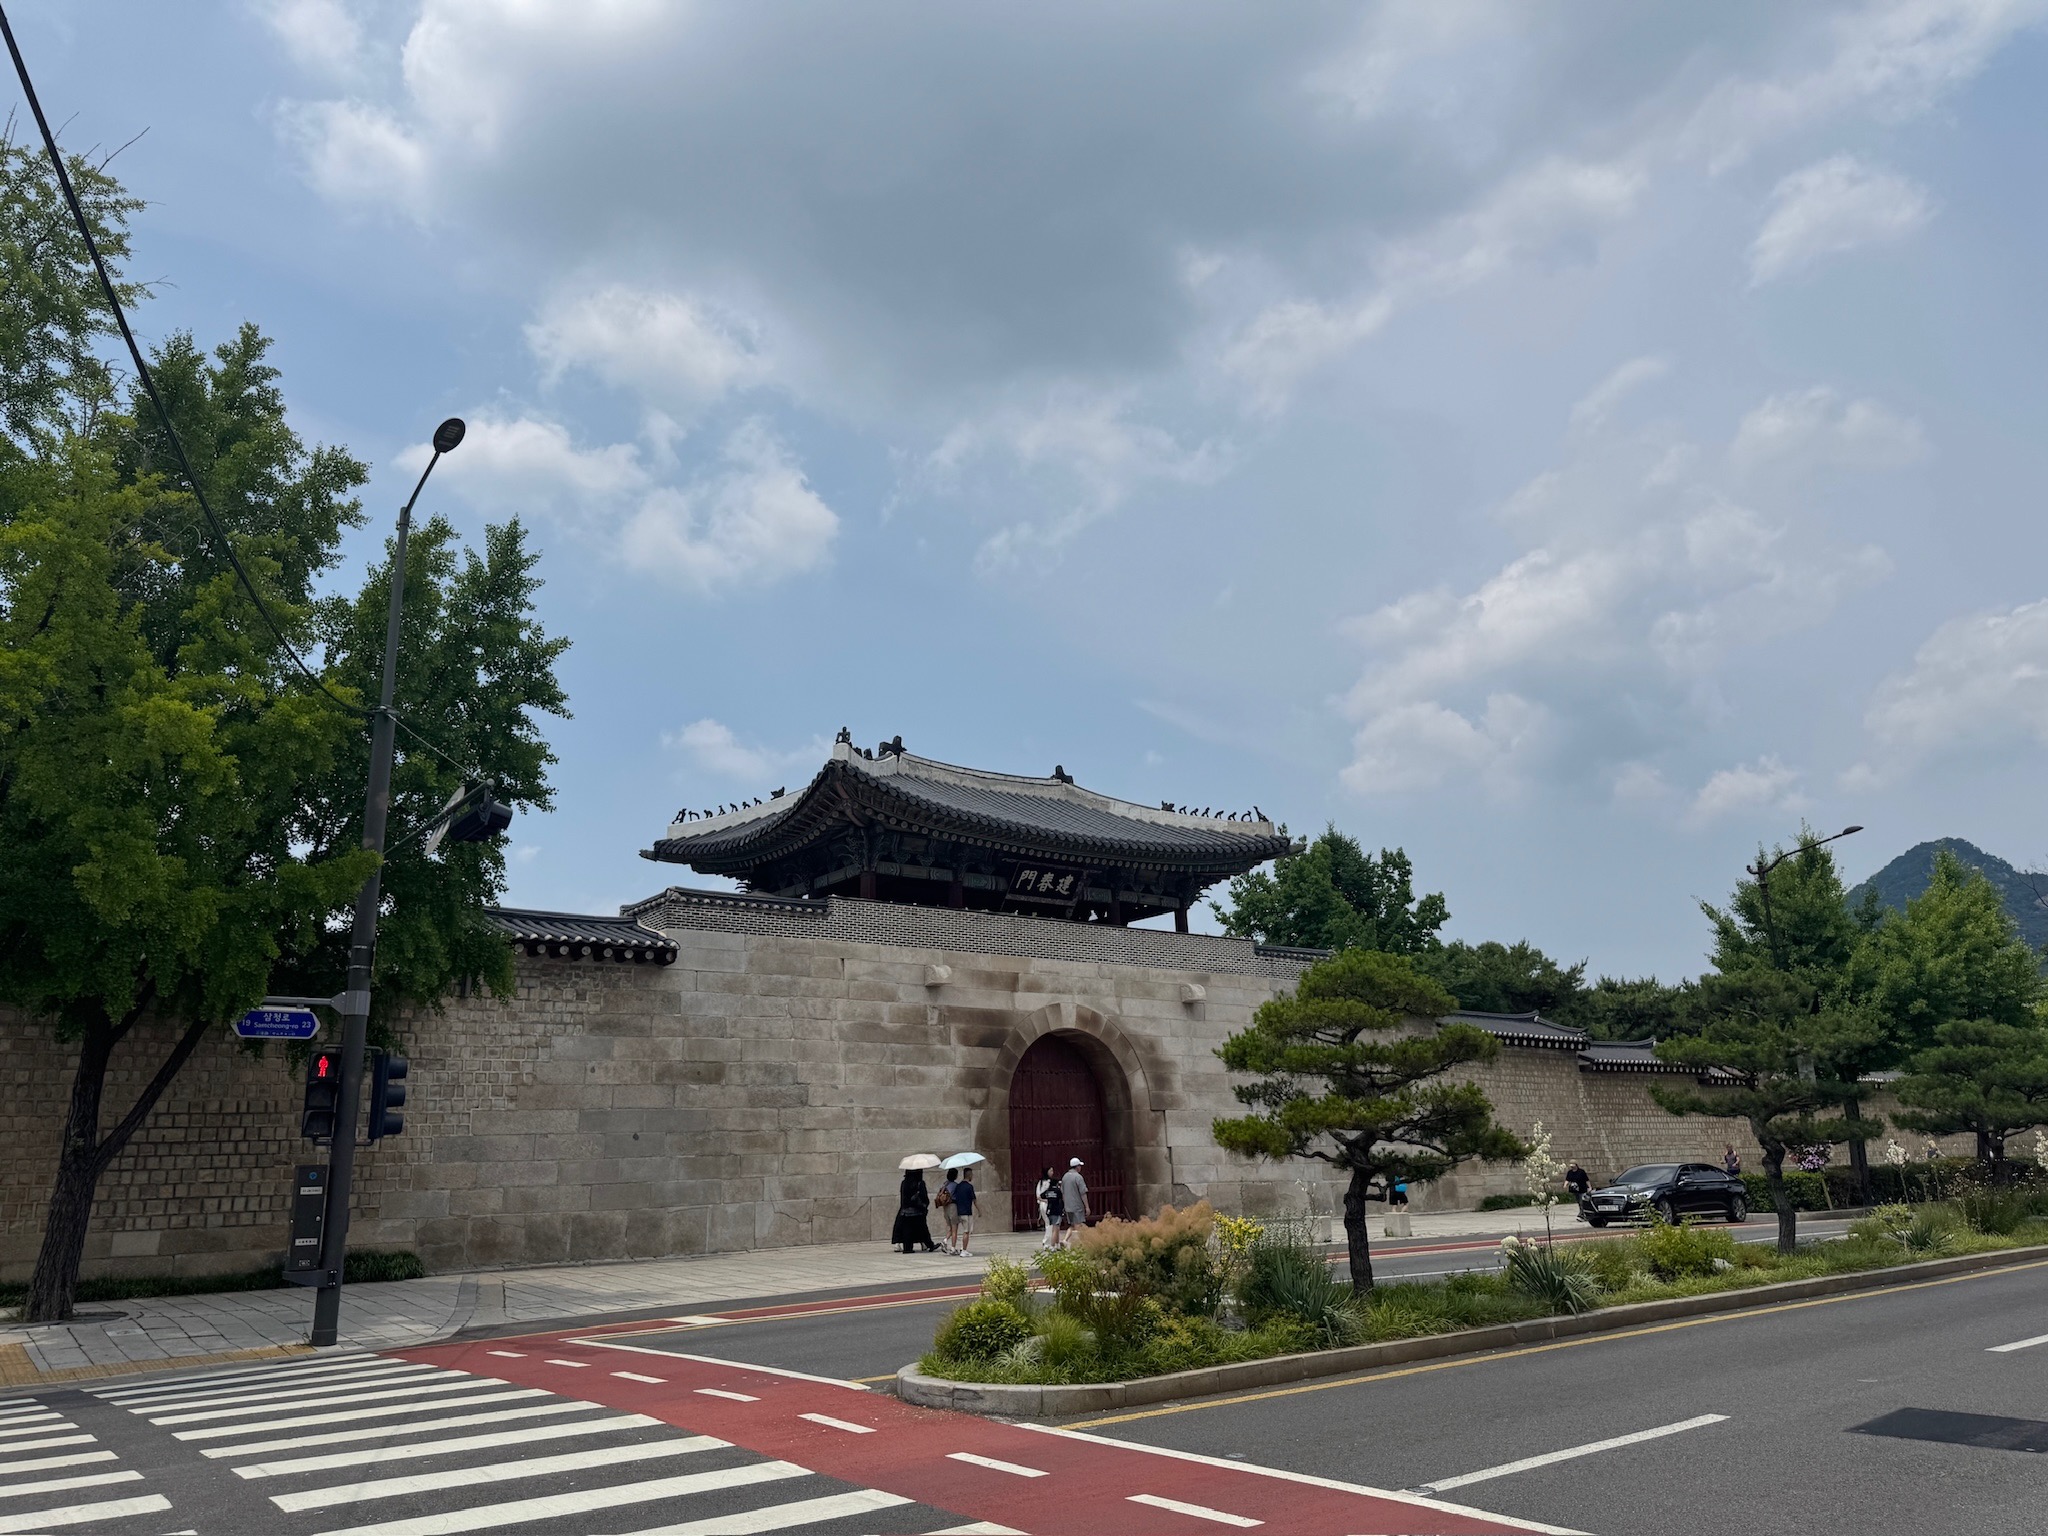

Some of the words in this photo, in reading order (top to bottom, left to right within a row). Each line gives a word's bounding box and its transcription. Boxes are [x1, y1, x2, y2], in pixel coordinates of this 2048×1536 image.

[263, 1012, 290, 1022] 삼청로
[253, 1021, 299, 1030] Samcheong-ro
[301, 1021, 312, 1029] 23
